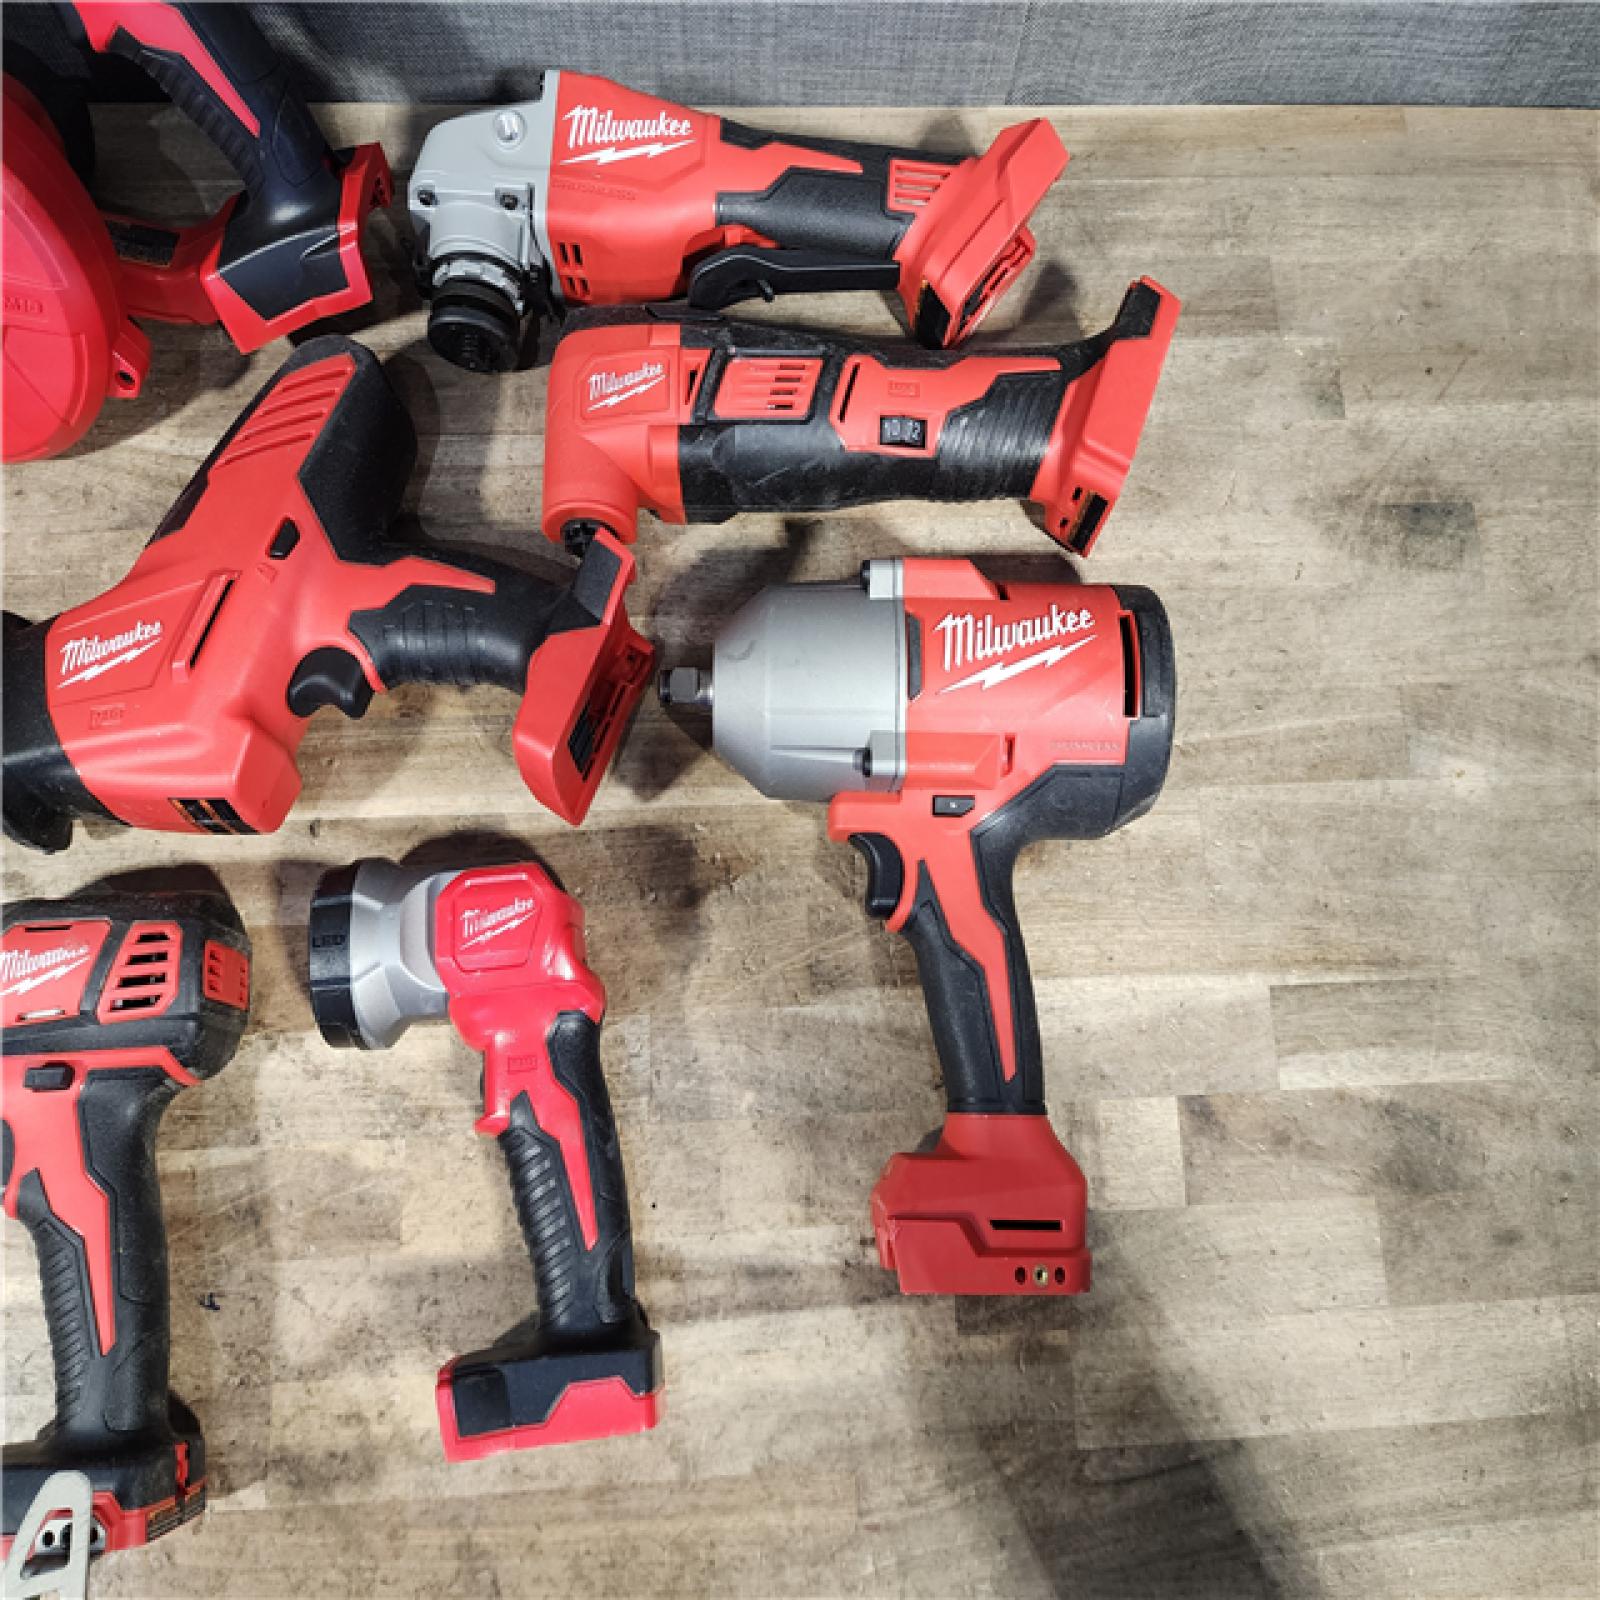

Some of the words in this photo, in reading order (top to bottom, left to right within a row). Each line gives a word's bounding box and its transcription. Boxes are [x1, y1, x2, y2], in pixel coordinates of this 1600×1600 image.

[562, 104, 693, 149] Milwaukee
[588, 361, 664, 401] Milwaukee
[60, 620, 162, 676] Milwaukee
[933, 603, 1096, 673] Milwaukee
[460, 896, 534, 937] Milwaukee
